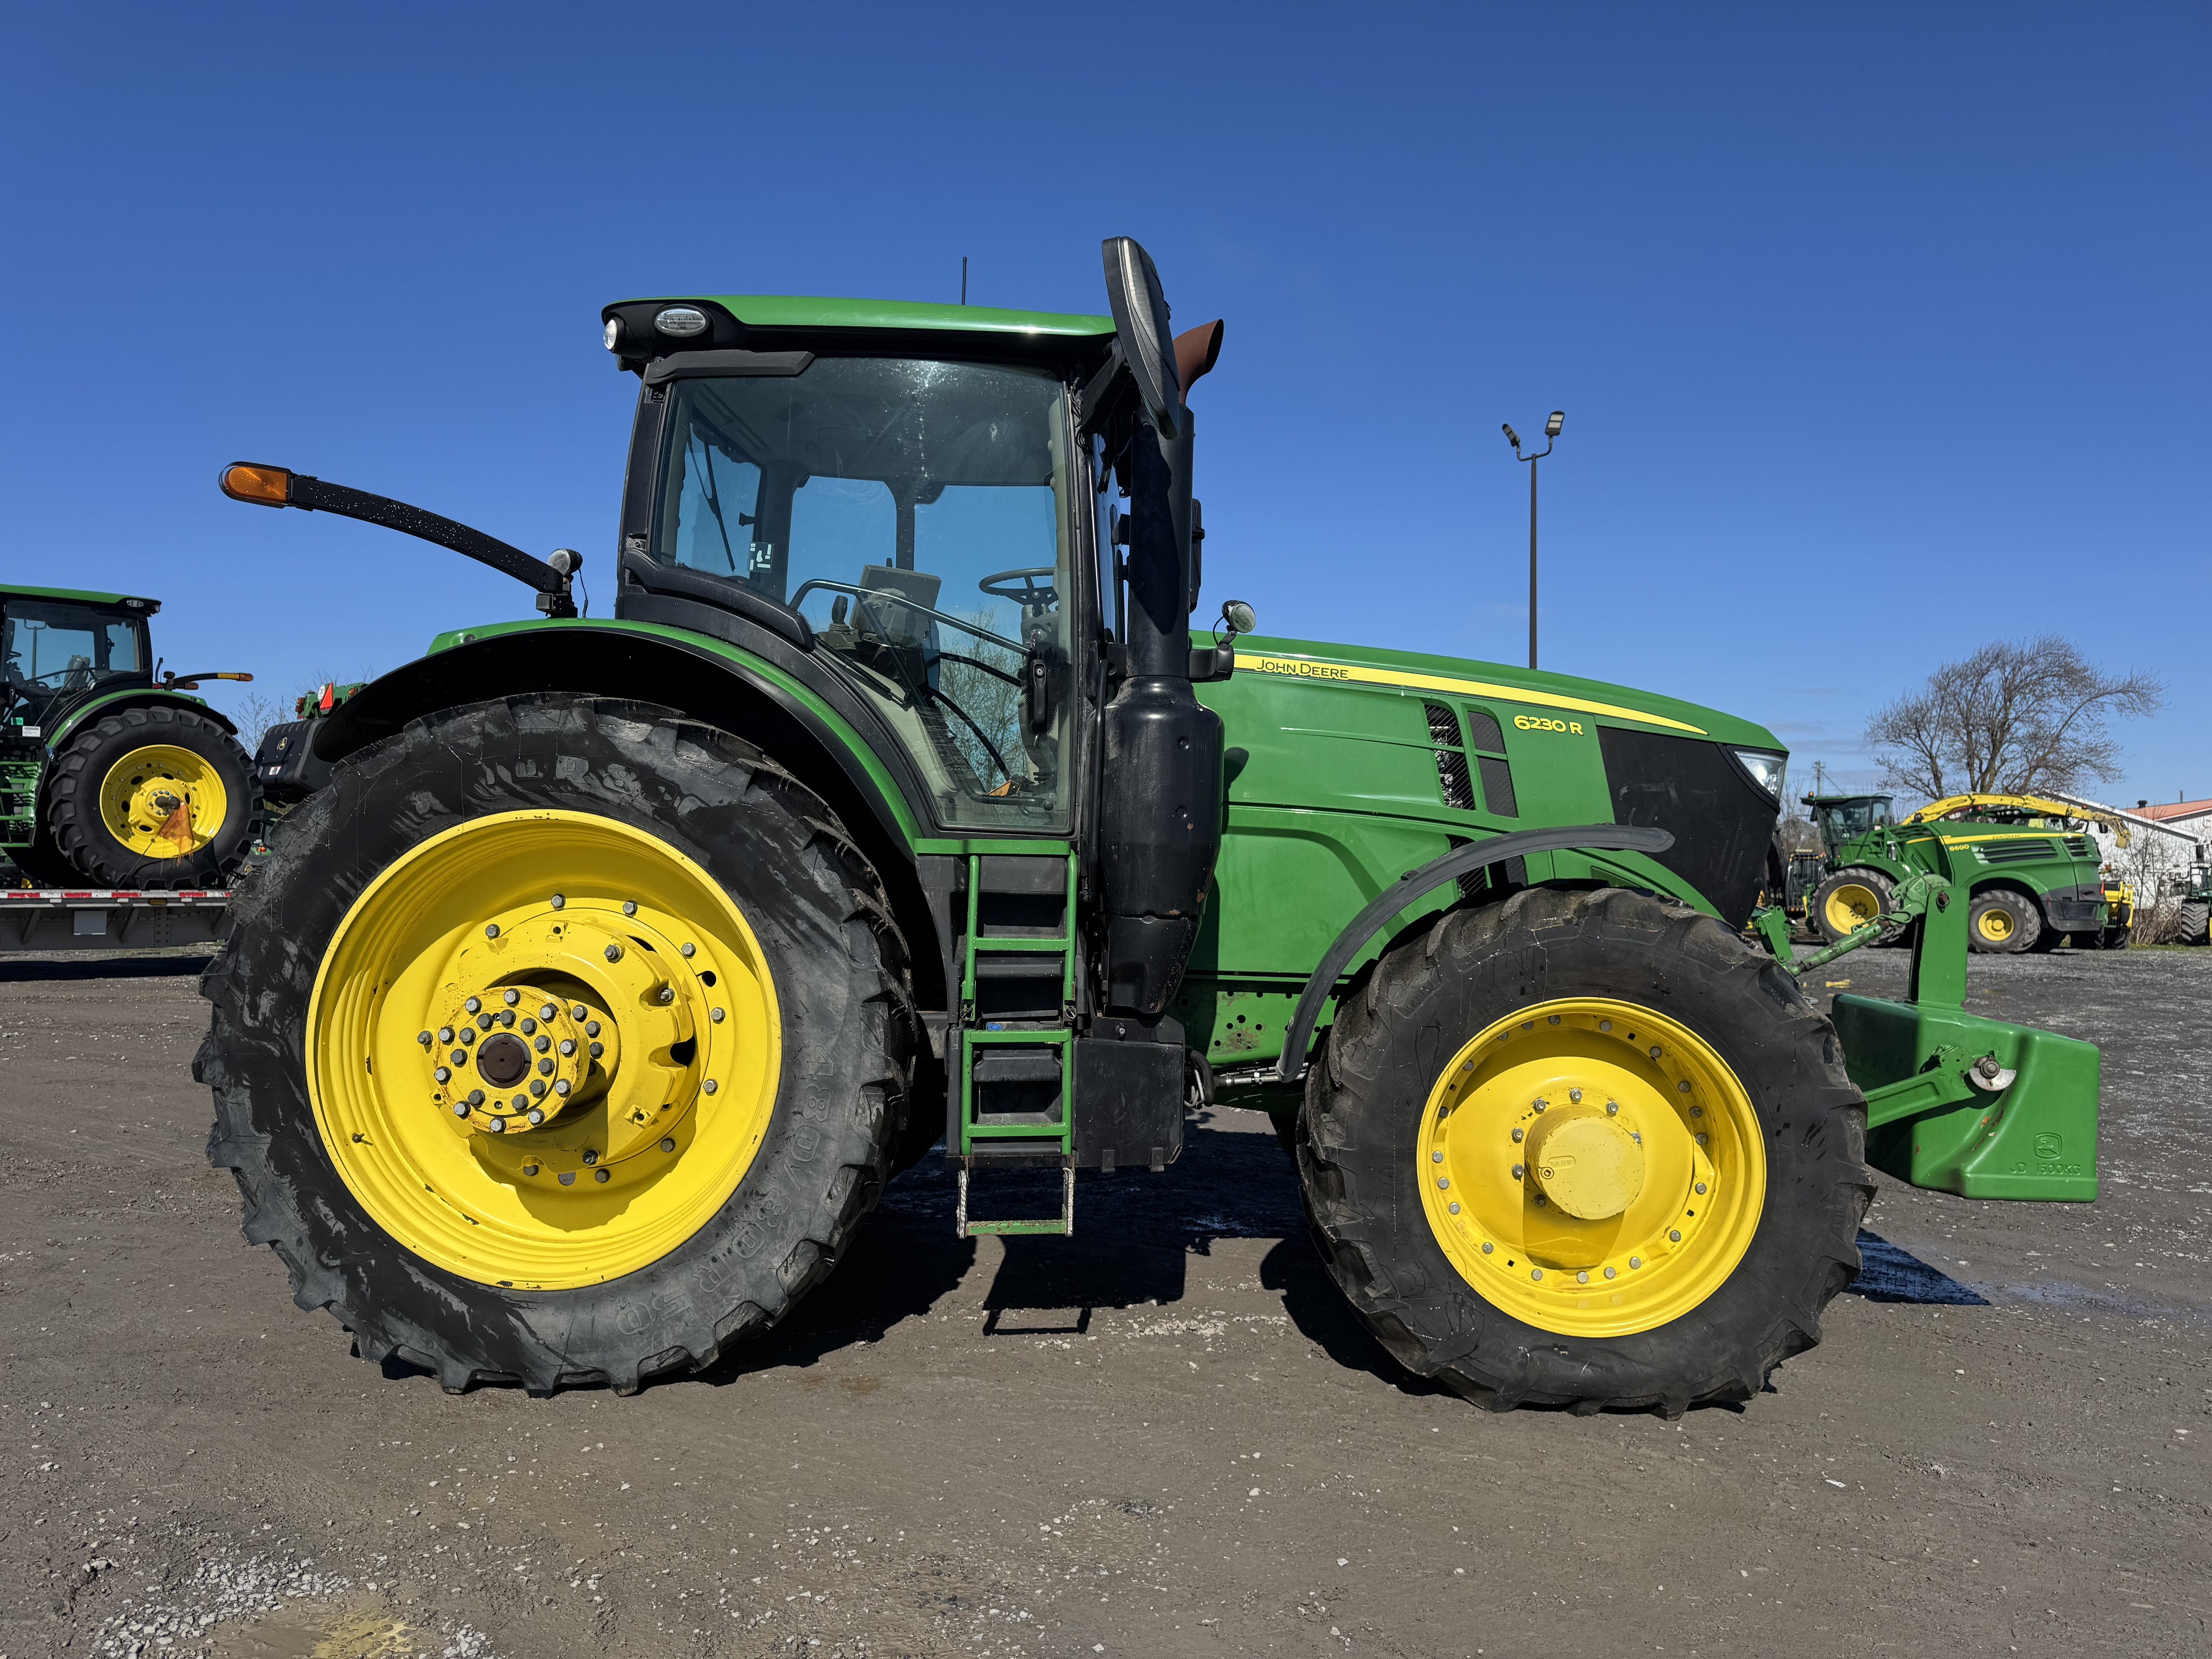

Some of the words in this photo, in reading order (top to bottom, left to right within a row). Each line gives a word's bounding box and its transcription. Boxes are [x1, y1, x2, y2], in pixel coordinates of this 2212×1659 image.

[1257, 659, 1296, 673] JOHN
[1300, 663, 1349, 678] DEERE
[1513, 715, 1567, 733] 6230
[1569, 721, 1584, 735] R
[603, 761, 712, 830] 800
[730, 1044, 835, 1259] 480/80
[2010, 1162, 2026, 1173] JD
[2036, 1163, 2081, 1175] 1500KG
[615, 1291, 694, 1336] 50
